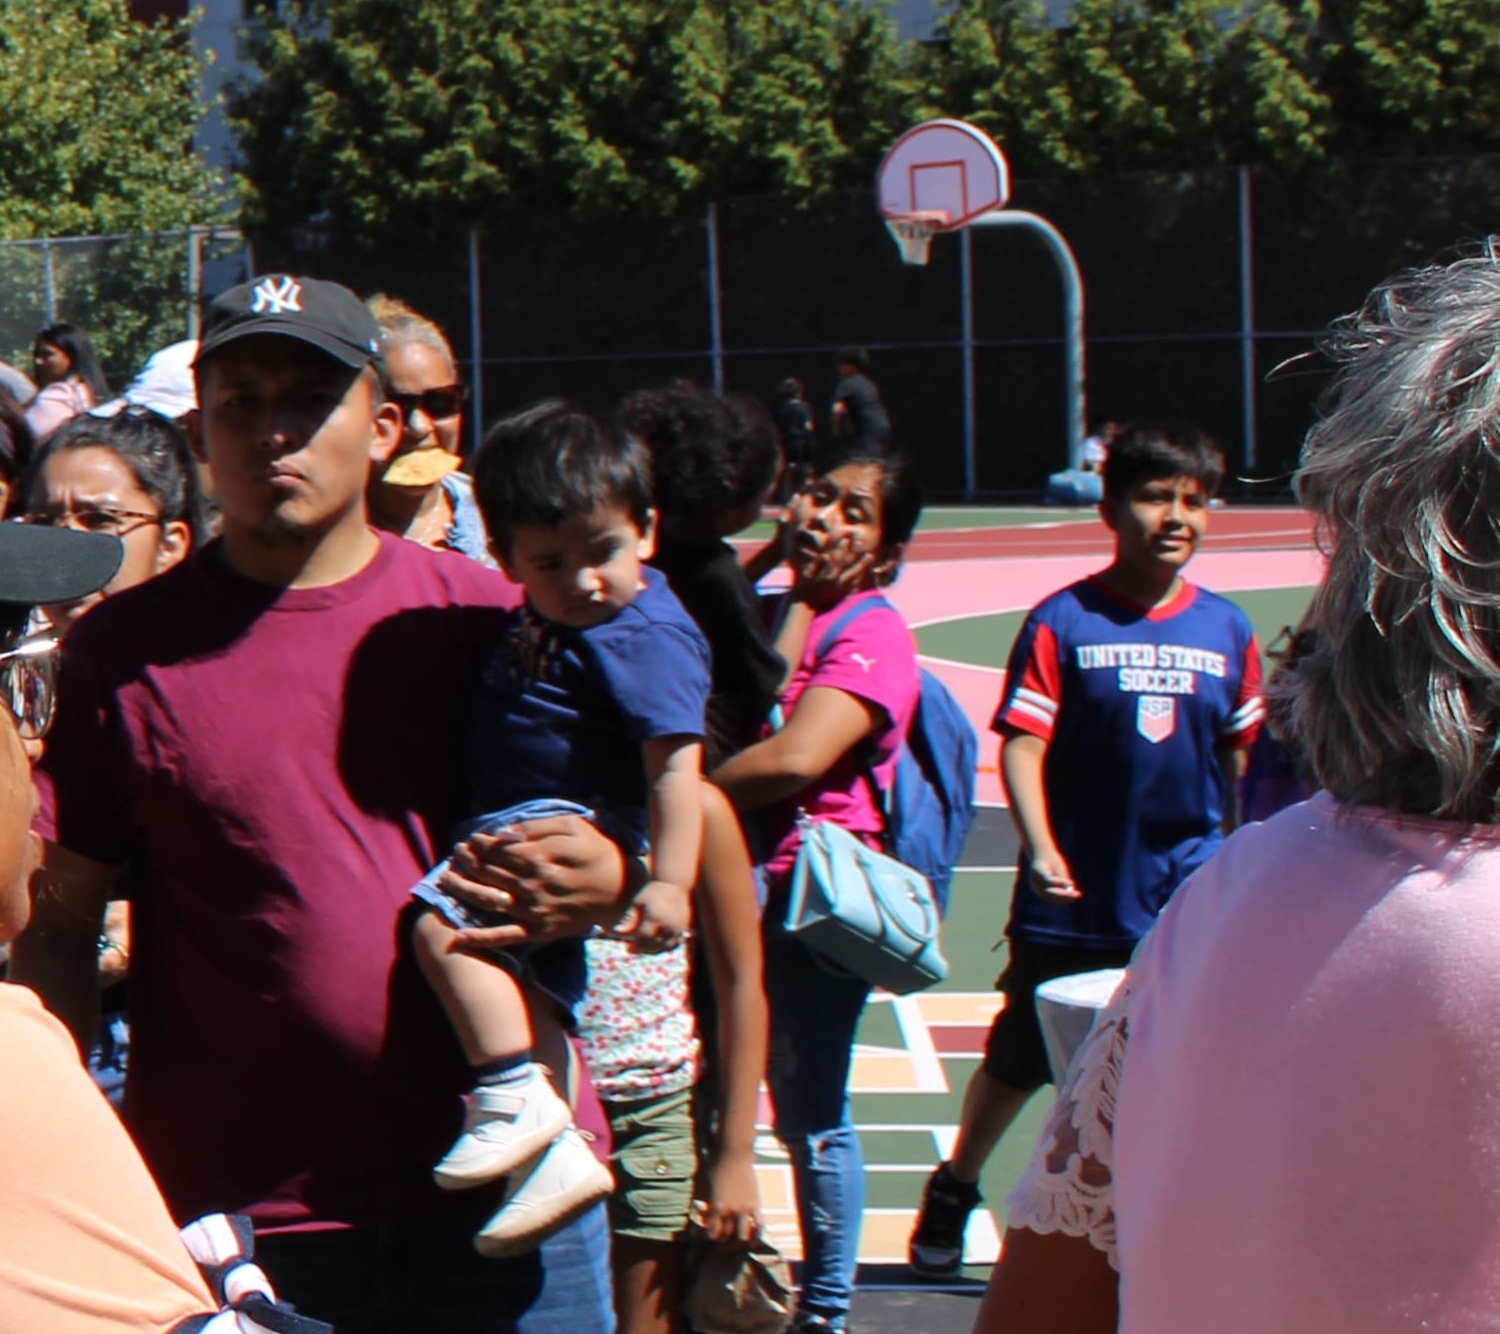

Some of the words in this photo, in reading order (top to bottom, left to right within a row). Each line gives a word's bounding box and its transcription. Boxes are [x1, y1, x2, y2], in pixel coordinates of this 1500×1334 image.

[251, 275, 302, 313] NY
[1076, 643, 1156, 669] UNITED
[1157, 644, 1228, 678] STATES
[1118, 668, 1196, 694] SOCCER
